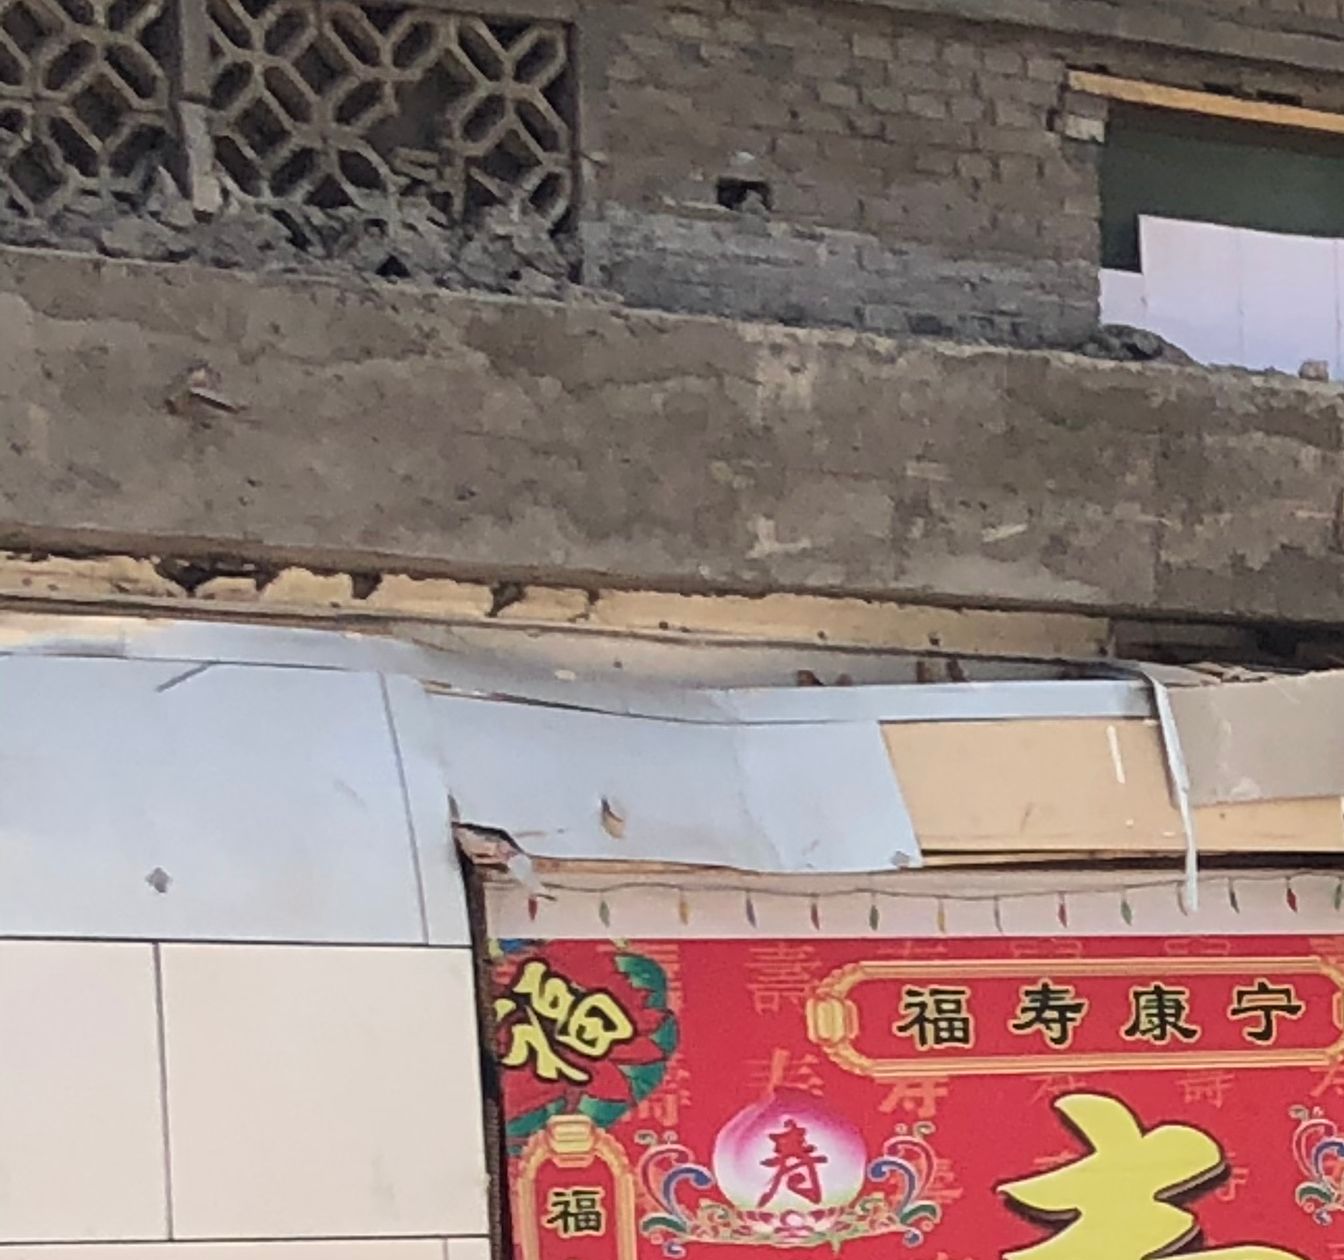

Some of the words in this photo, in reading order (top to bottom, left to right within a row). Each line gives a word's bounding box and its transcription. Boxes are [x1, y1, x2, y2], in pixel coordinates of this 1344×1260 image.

[898, 977, 1302, 1047] 福寿康宁
[760, 1119, 829, 1208] 寿
